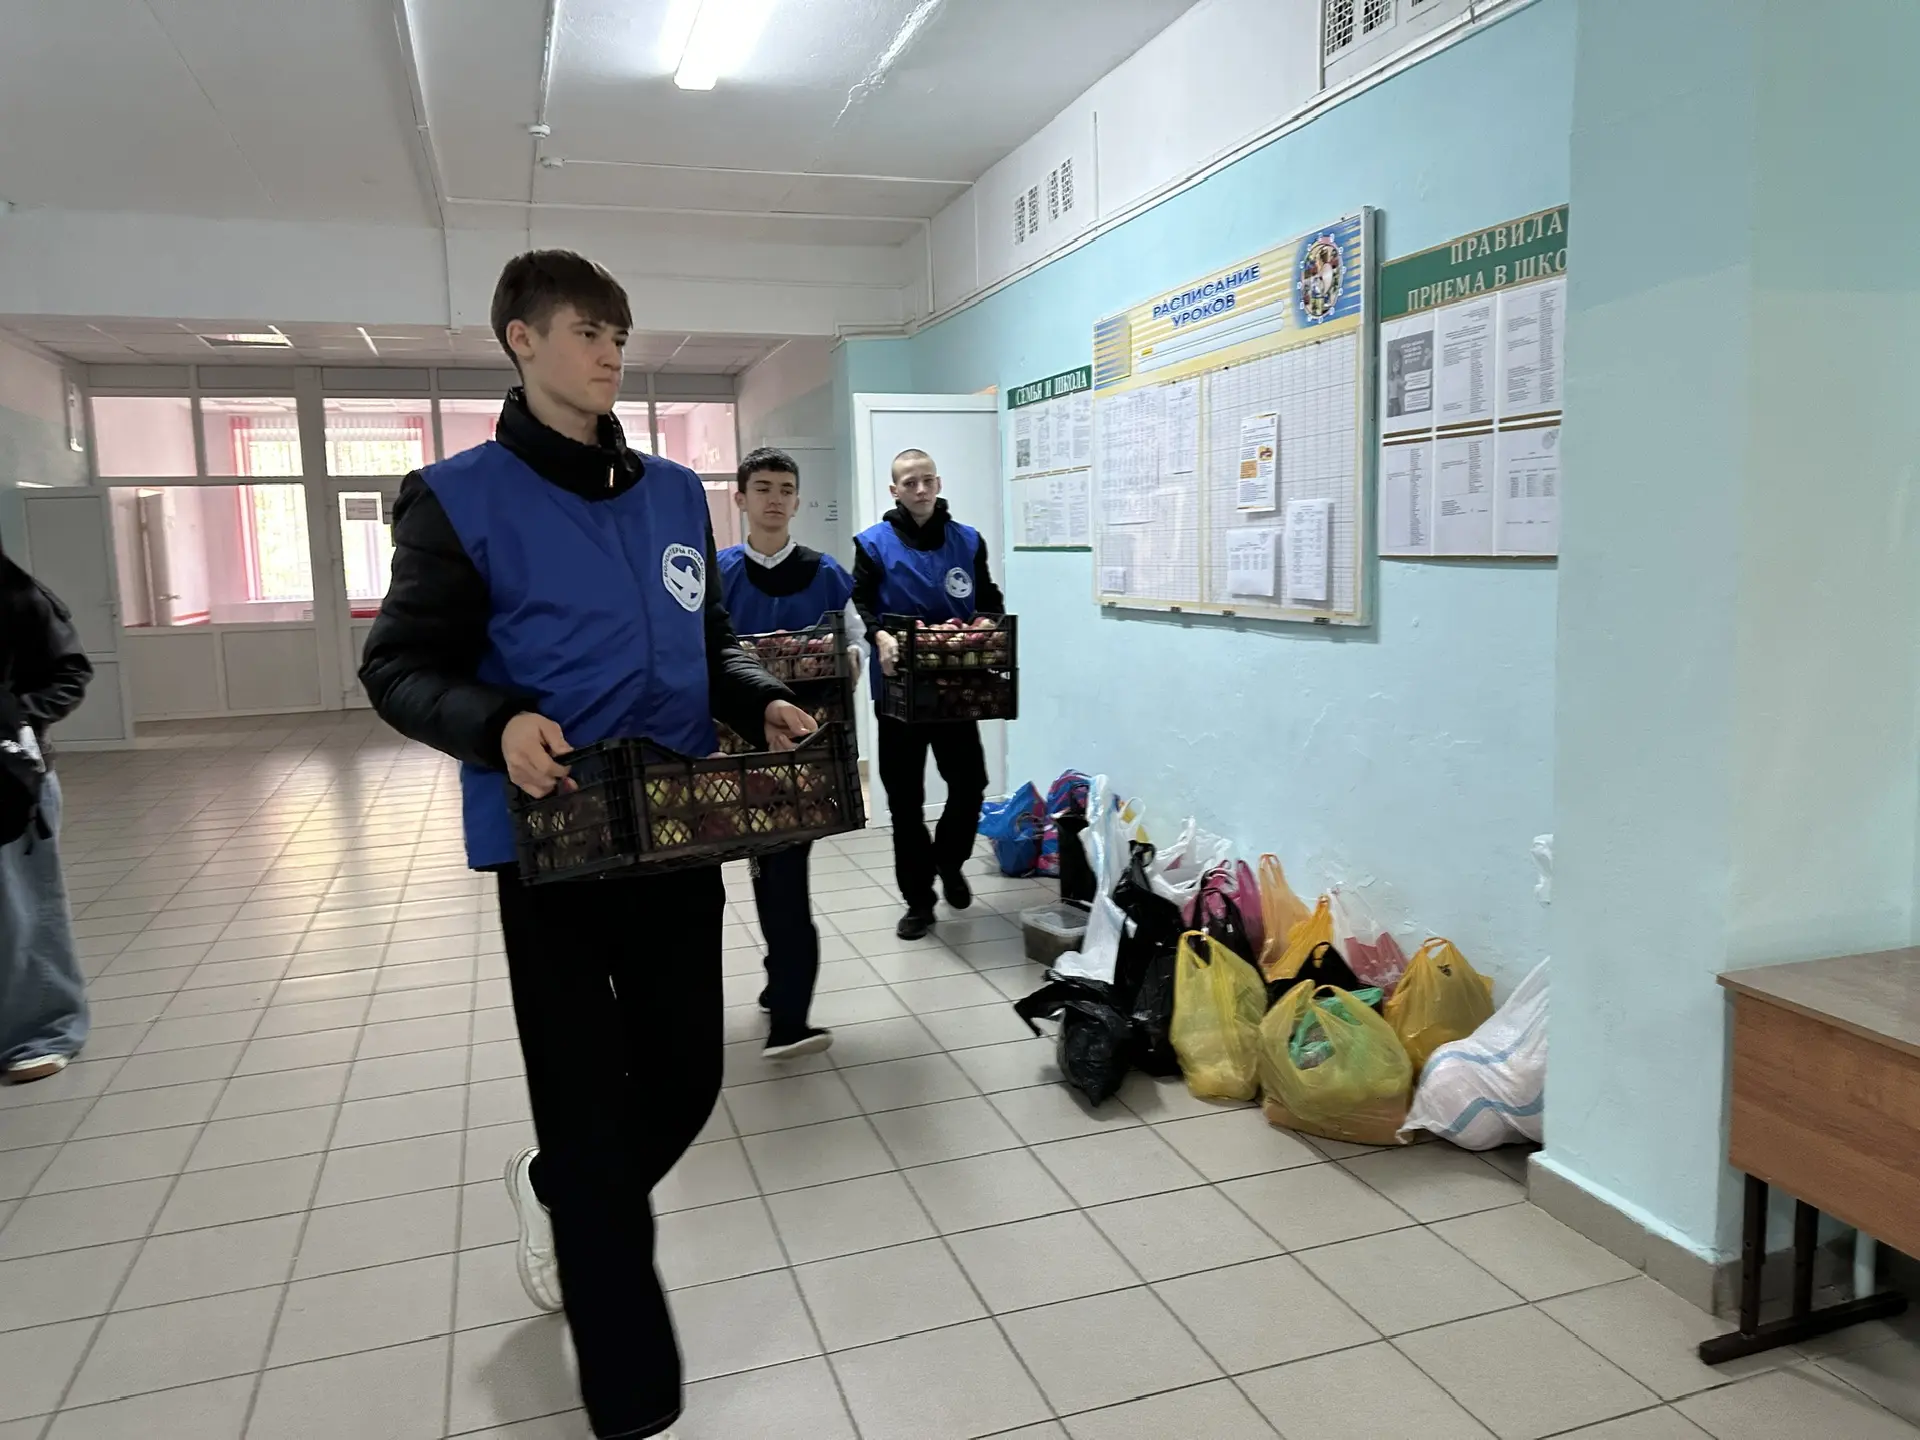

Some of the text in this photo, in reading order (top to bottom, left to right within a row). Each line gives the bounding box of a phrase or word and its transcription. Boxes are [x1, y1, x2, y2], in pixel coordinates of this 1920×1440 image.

[1450, 211, 1564, 265] ПРАВИЛА
[1152, 263, 1260, 319] РАСПИСАНИЕ
[1407, 248, 1568, 311] ПРИЕМА В ШКО
[1171, 292, 1236, 328] УРОКОВ
[1016, 370, 1088, 406] СЕМЬЯ И ШКОЛА
